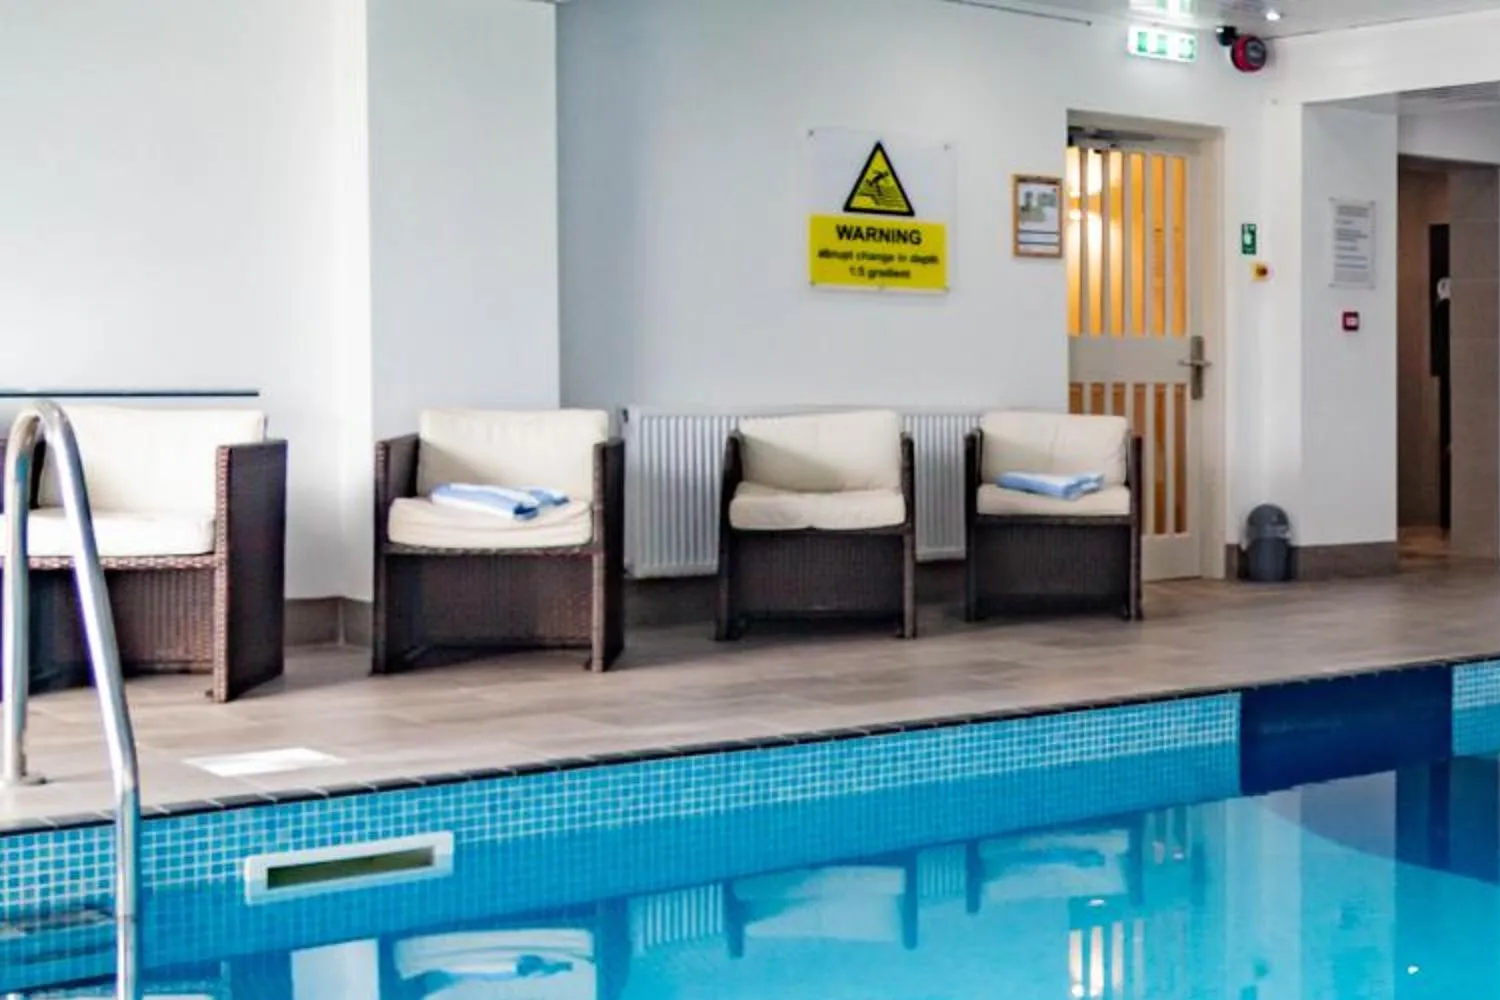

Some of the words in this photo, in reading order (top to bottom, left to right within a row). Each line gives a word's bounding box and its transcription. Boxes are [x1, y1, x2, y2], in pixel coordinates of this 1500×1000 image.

[836, 223, 922, 245] WARNING
[856, 251, 895, 263] change
[867, 267, 911, 279] gradient
